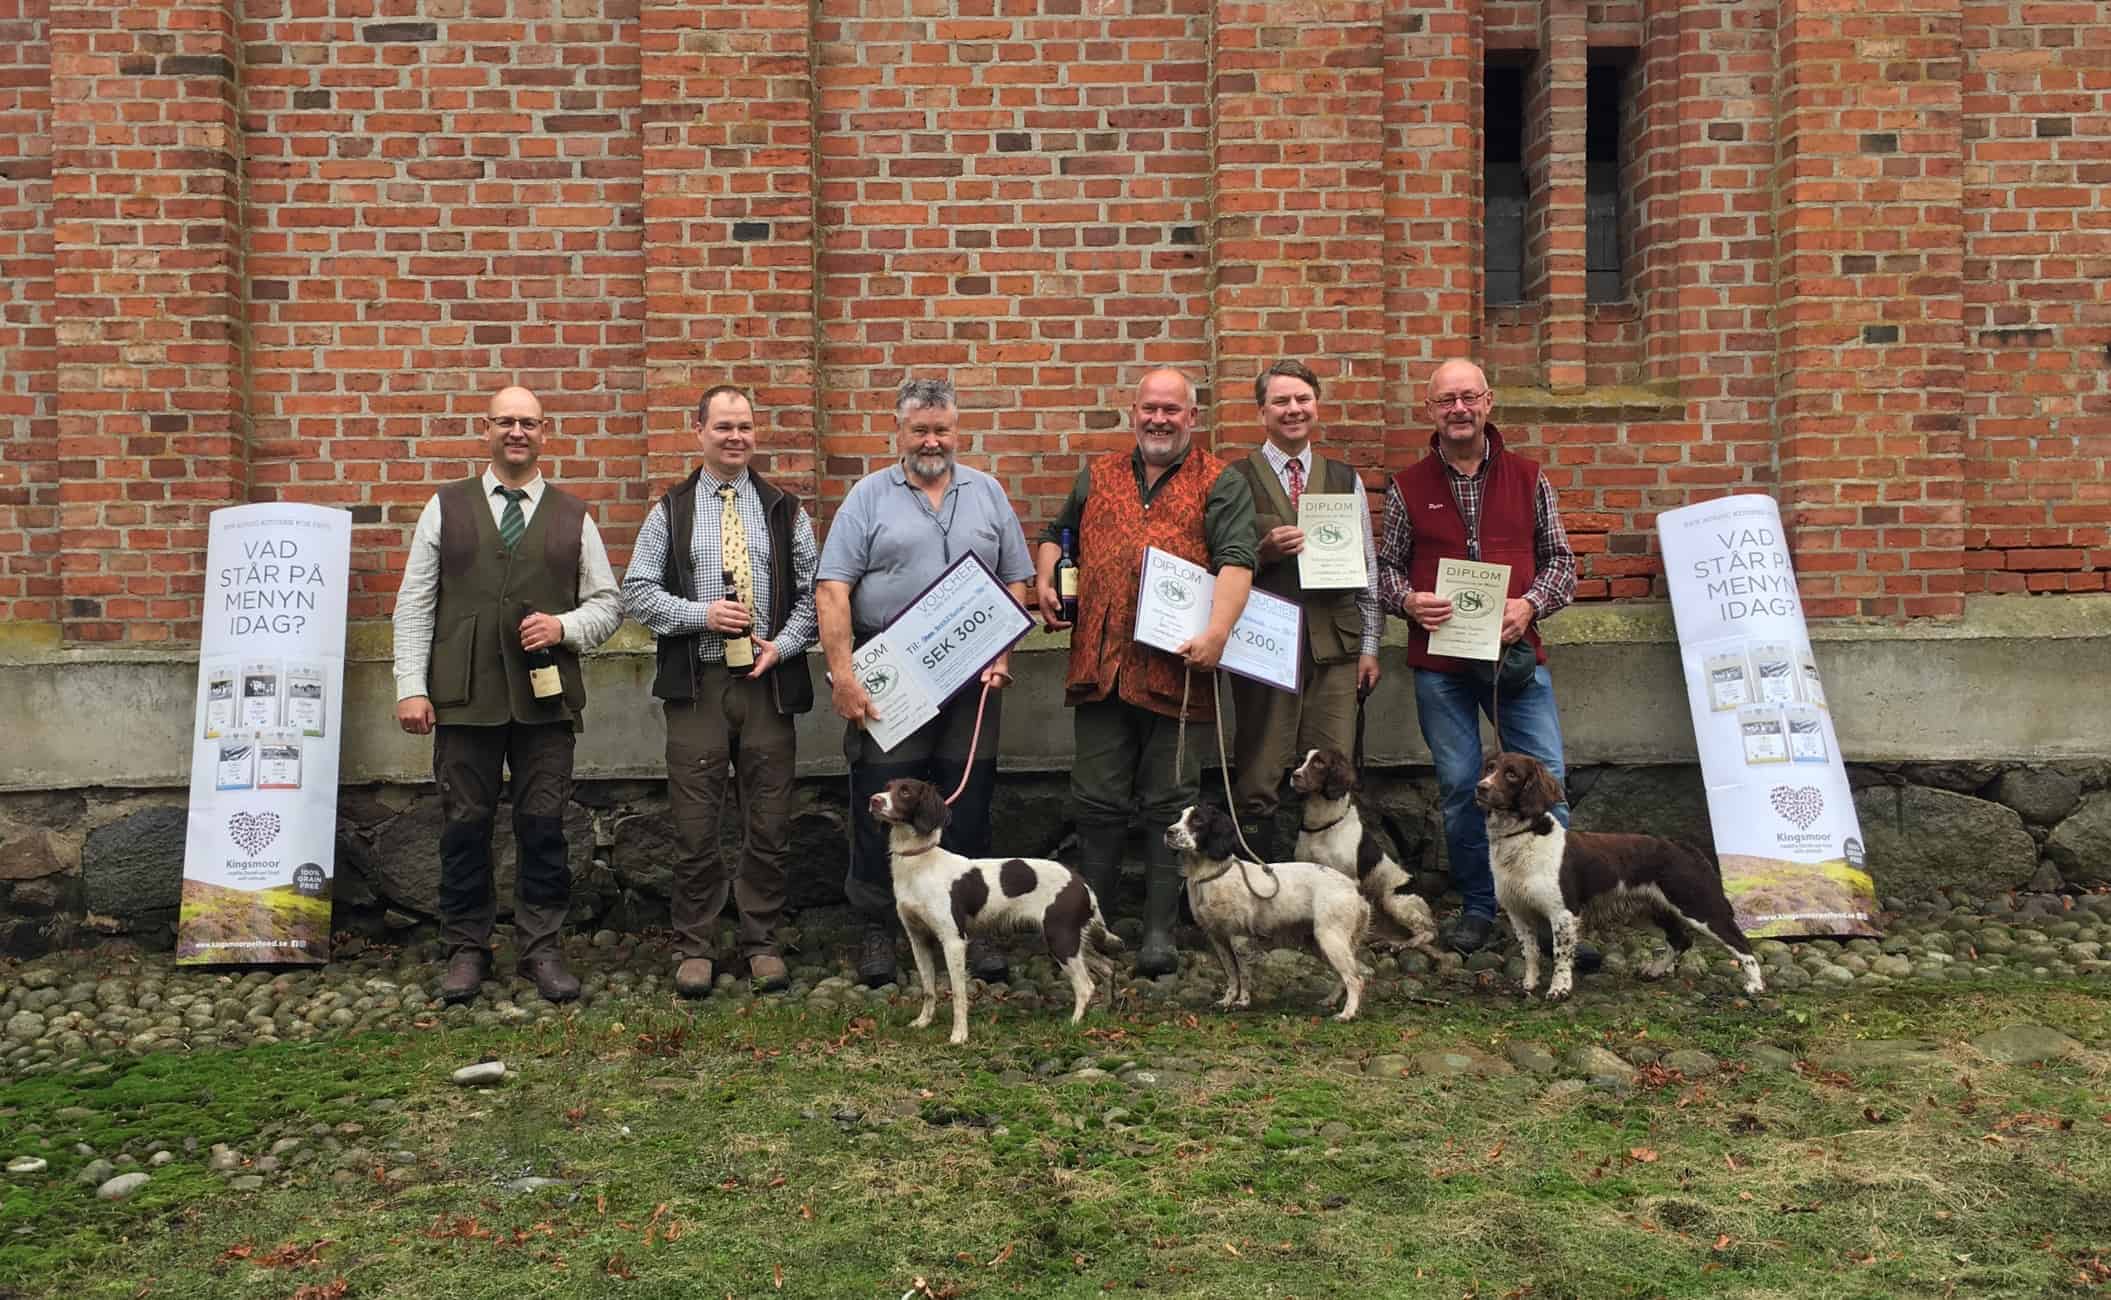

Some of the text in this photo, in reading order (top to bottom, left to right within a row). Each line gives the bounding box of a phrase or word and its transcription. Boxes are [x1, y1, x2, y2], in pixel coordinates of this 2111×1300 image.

[1305, 502, 1353, 513] DIPLOM
[244, 539, 298, 560] VAD
[1717, 528, 1775, 549] VAD
[220, 561, 325, 588] STÅR PÅ
[1152, 556, 1202, 585] DIPLOM
[1446, 567, 1502, 581] DIPLOM
[1694, 550, 1767, 578] STÅR
[917, 560, 977, 612] VOUCHER
[225, 589, 315, 611] MENYN
[1720, 598, 1796, 622] IDAG?
[229, 614, 306, 636] IDAG?
[922, 637, 956, 670] SEK
[953, 604, 995, 641] 300,-
[852, 642, 889, 672] PLOM
[1776, 831, 1832, 844] Kingsmoor
[226, 858, 281, 871] Kingsmoor
[299, 882, 321, 890] FREE
